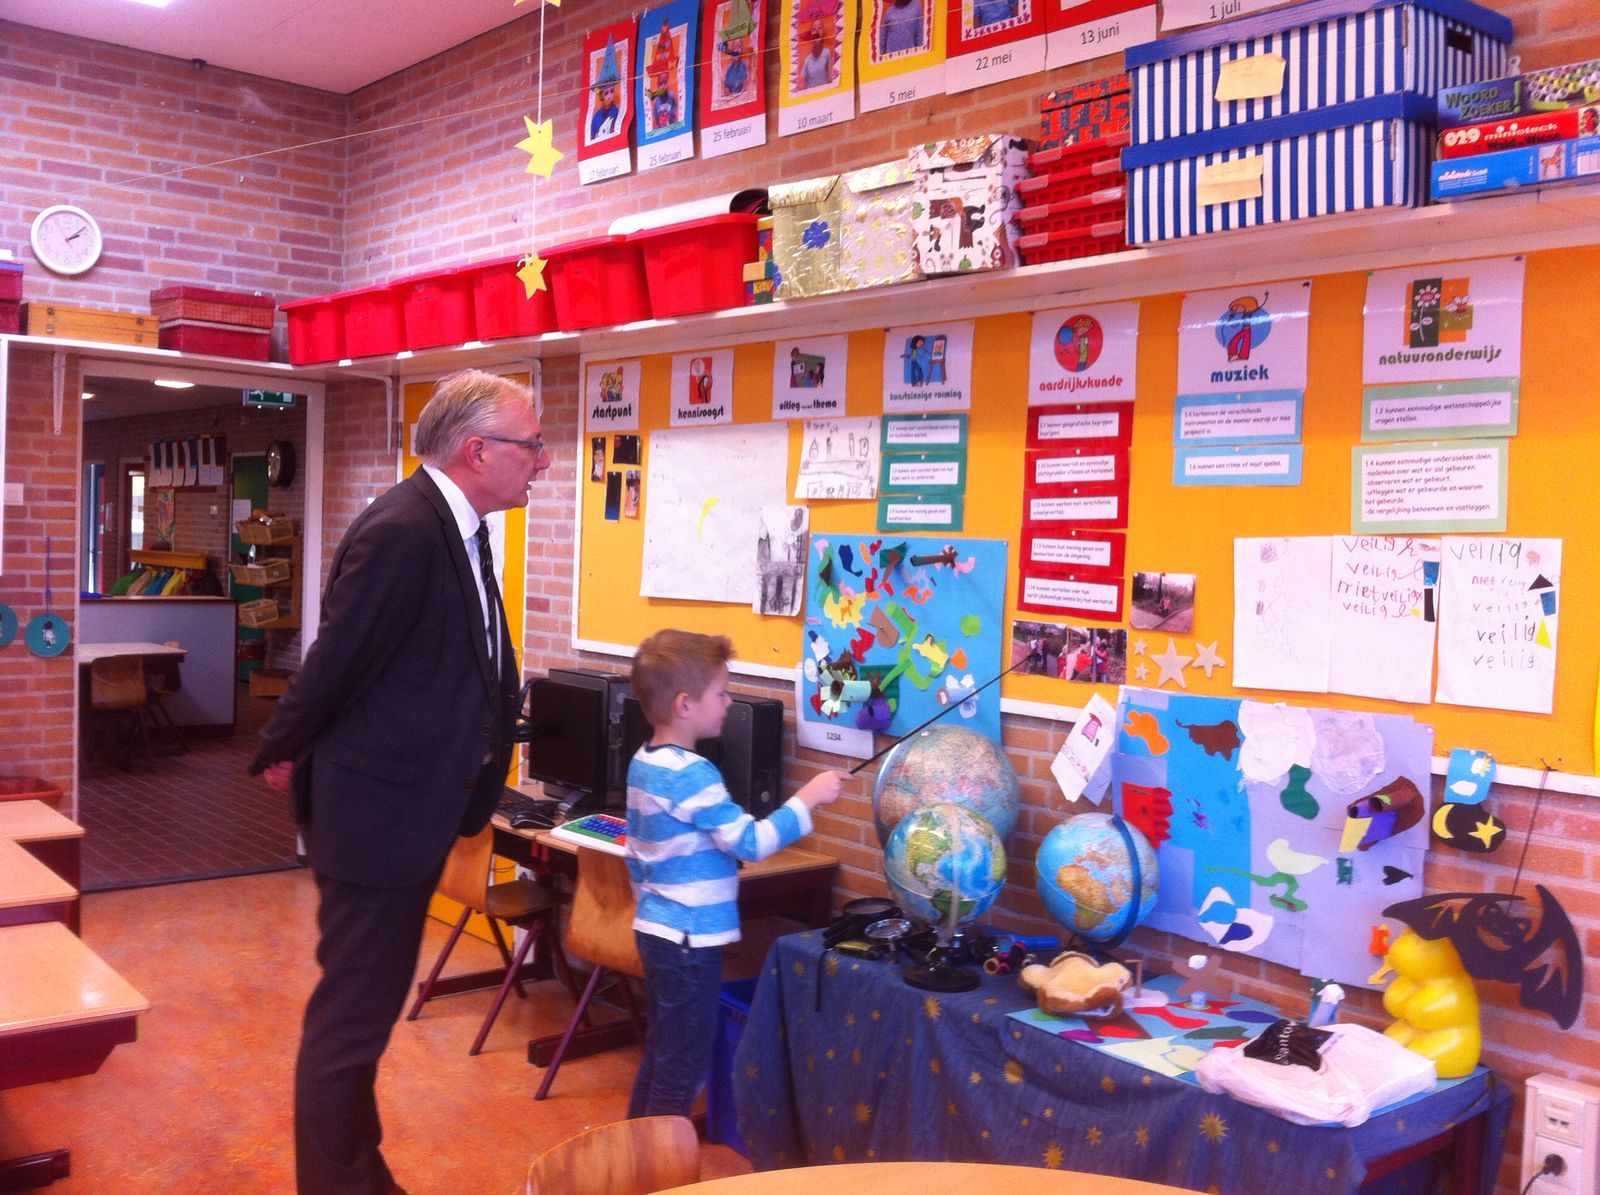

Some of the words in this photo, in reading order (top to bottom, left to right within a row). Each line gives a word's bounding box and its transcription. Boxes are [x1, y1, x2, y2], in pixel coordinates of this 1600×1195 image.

[1210, 5, 1217, 19] 1
[1220, 0, 1241, 20] juli
[1080, 31, 1094, 45] 13
[1096, 22, 1119, 44] juni
[975, 56, 988, 71] 22
[990, 50, 1012, 68] mei
[889, 91, 896, 104] 5
[897, 86, 916, 101] mei
[797, 117, 807, 129] 10
[808, 111, 833, 125] maart
[713, 131, 722, 142] 25
[723, 123, 751, 140] februari
[1444, 127, 1481, 147] 029
[649, 156, 657, 167] 25
[658, 148, 682, 164] februari
[1379, 345, 1502, 365] natuuronderwijs
[1039, 374, 1123, 392] aardrijkskunde
[1211, 365, 1269, 383] muziek
[934, 390, 962, 400] vorming
[592, 403, 632, 421] startpunt
[678, 405, 724, 419] kennisoogst
[779, 400, 800, 412] uitleg
[812, 399, 837, 409] thema
[1375, 459, 1396, 467] kunnen
[1477, 615, 1536, 644] veilig
[1473, 648, 1534, 669] veilig
[826, 732, 842, 741] 1234
